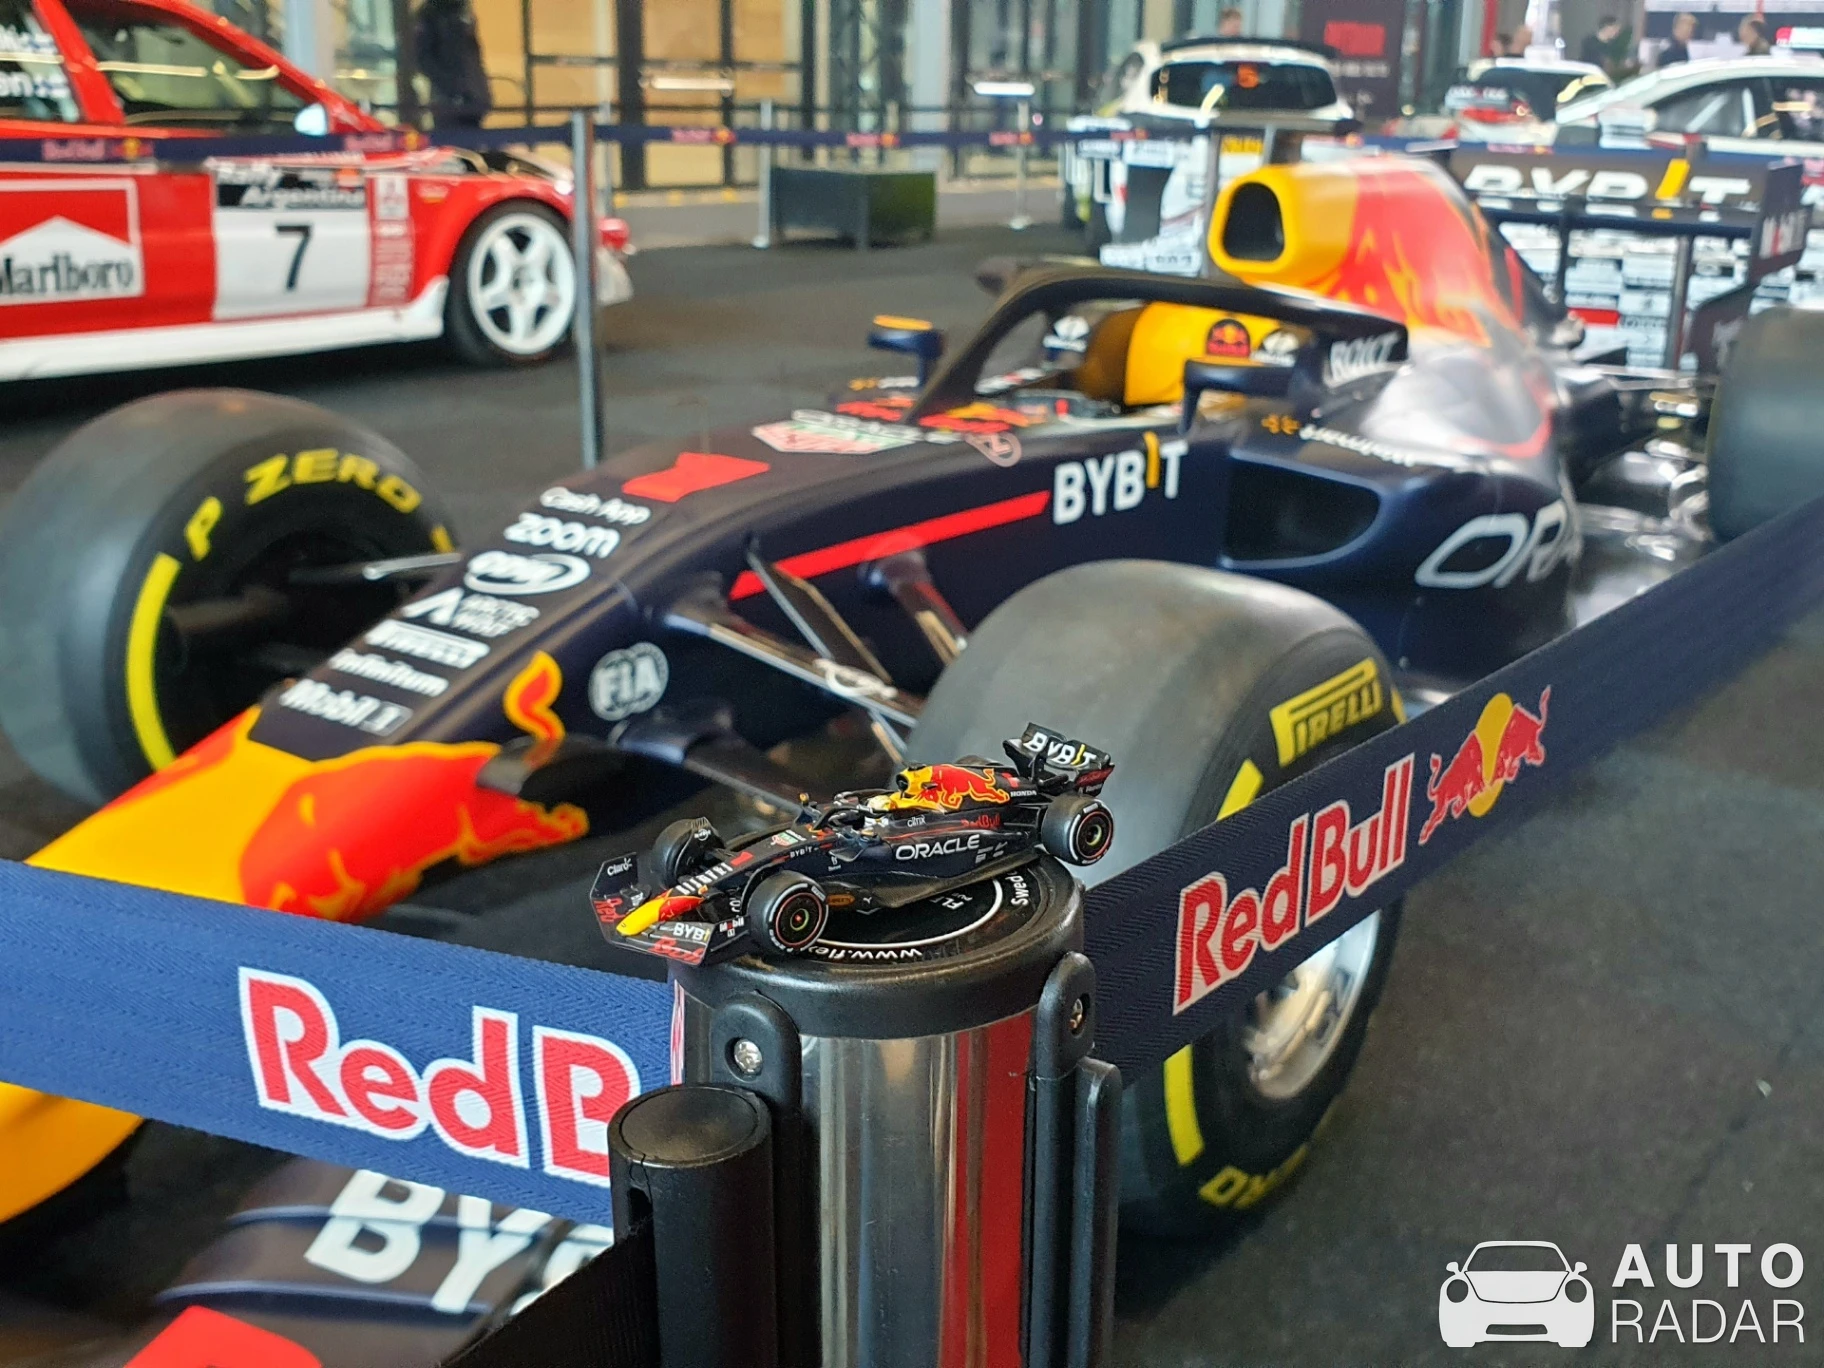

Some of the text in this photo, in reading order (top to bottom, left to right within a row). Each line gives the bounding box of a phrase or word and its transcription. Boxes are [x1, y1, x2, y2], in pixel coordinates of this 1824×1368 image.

[273, 223, 312, 291] 7
[184, 448, 422, 560] P ZERO
[1053, 431, 1188, 525] BYBIT
[503, 512, 621, 559] zoom
[594, 656, 661, 709] FIA
[1270, 657, 1384, 767] PIRELLI
[1023, 731, 1097, 770] BYBIT
[895, 833, 981, 861] ORACLE
